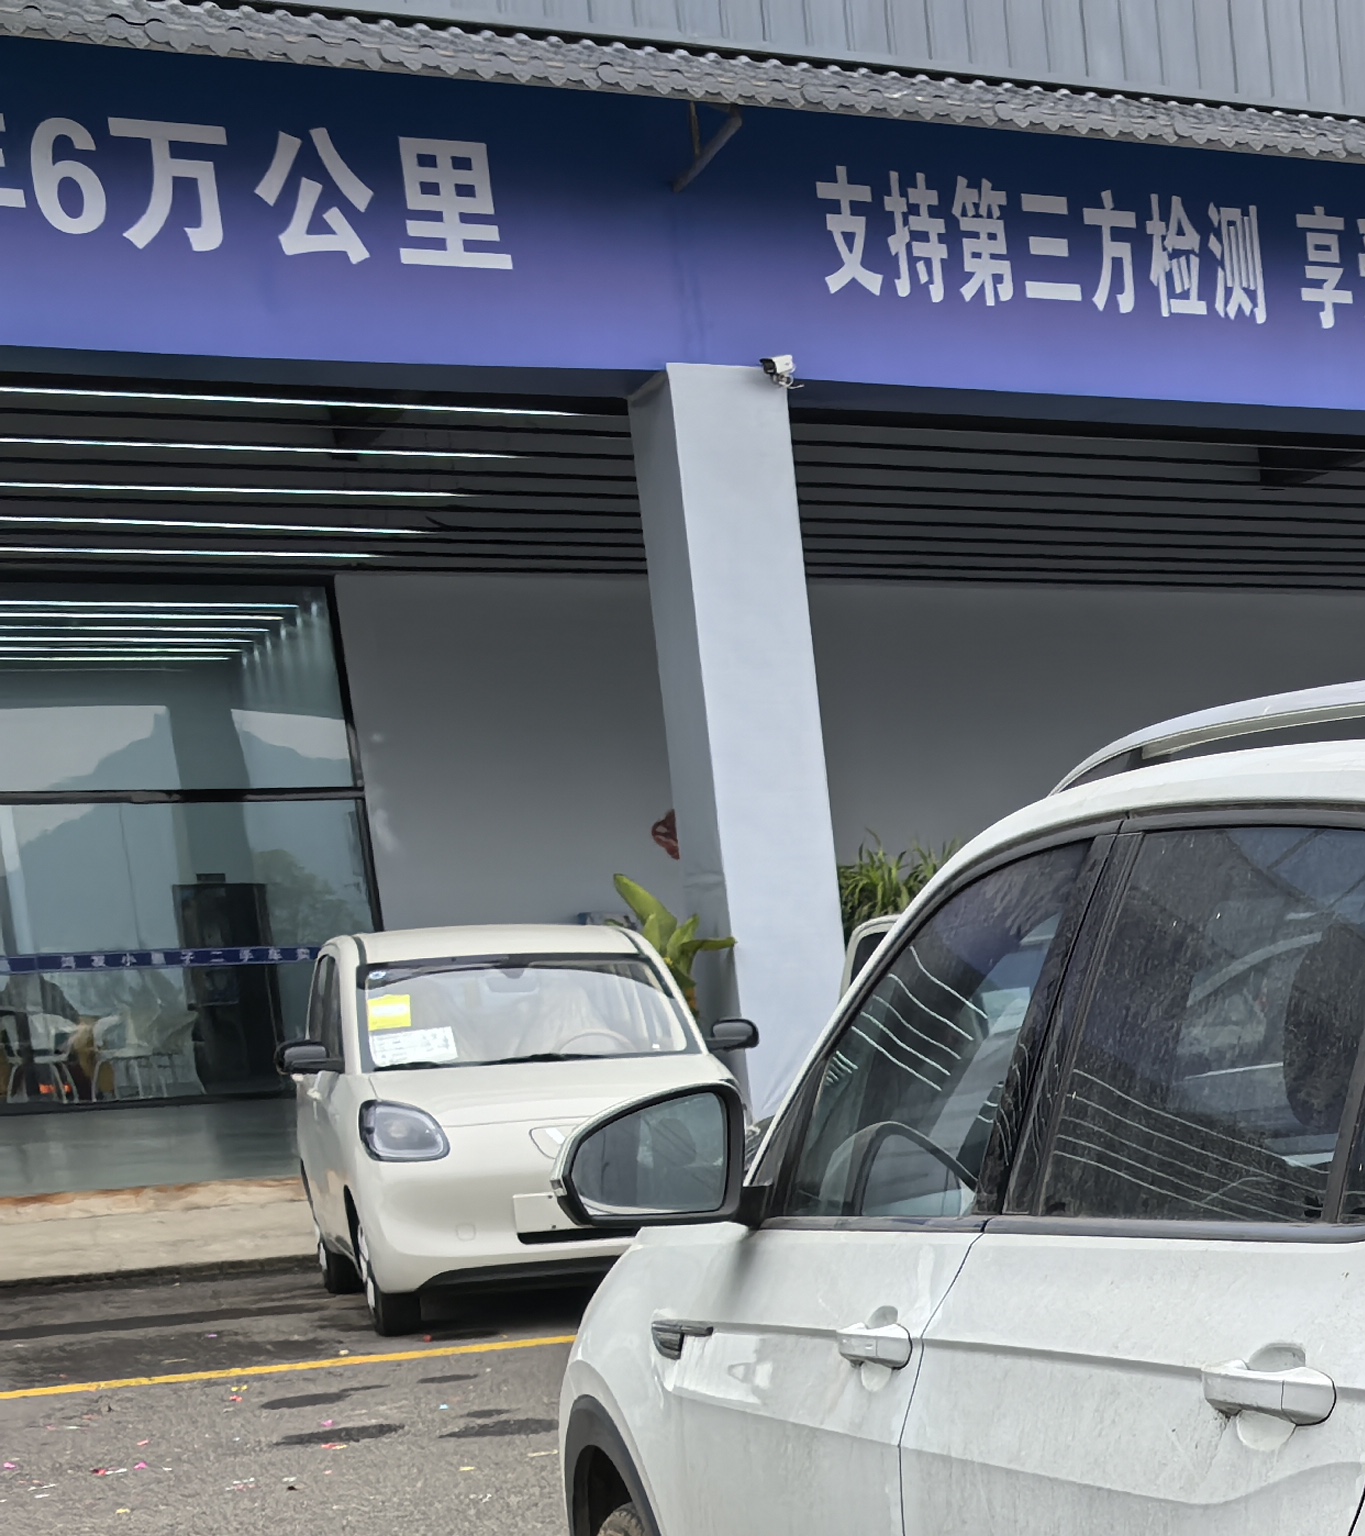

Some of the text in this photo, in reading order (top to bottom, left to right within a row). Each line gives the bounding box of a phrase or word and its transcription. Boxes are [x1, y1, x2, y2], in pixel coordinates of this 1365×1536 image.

[815, 165, 1268, 326] 支持第三方检测
